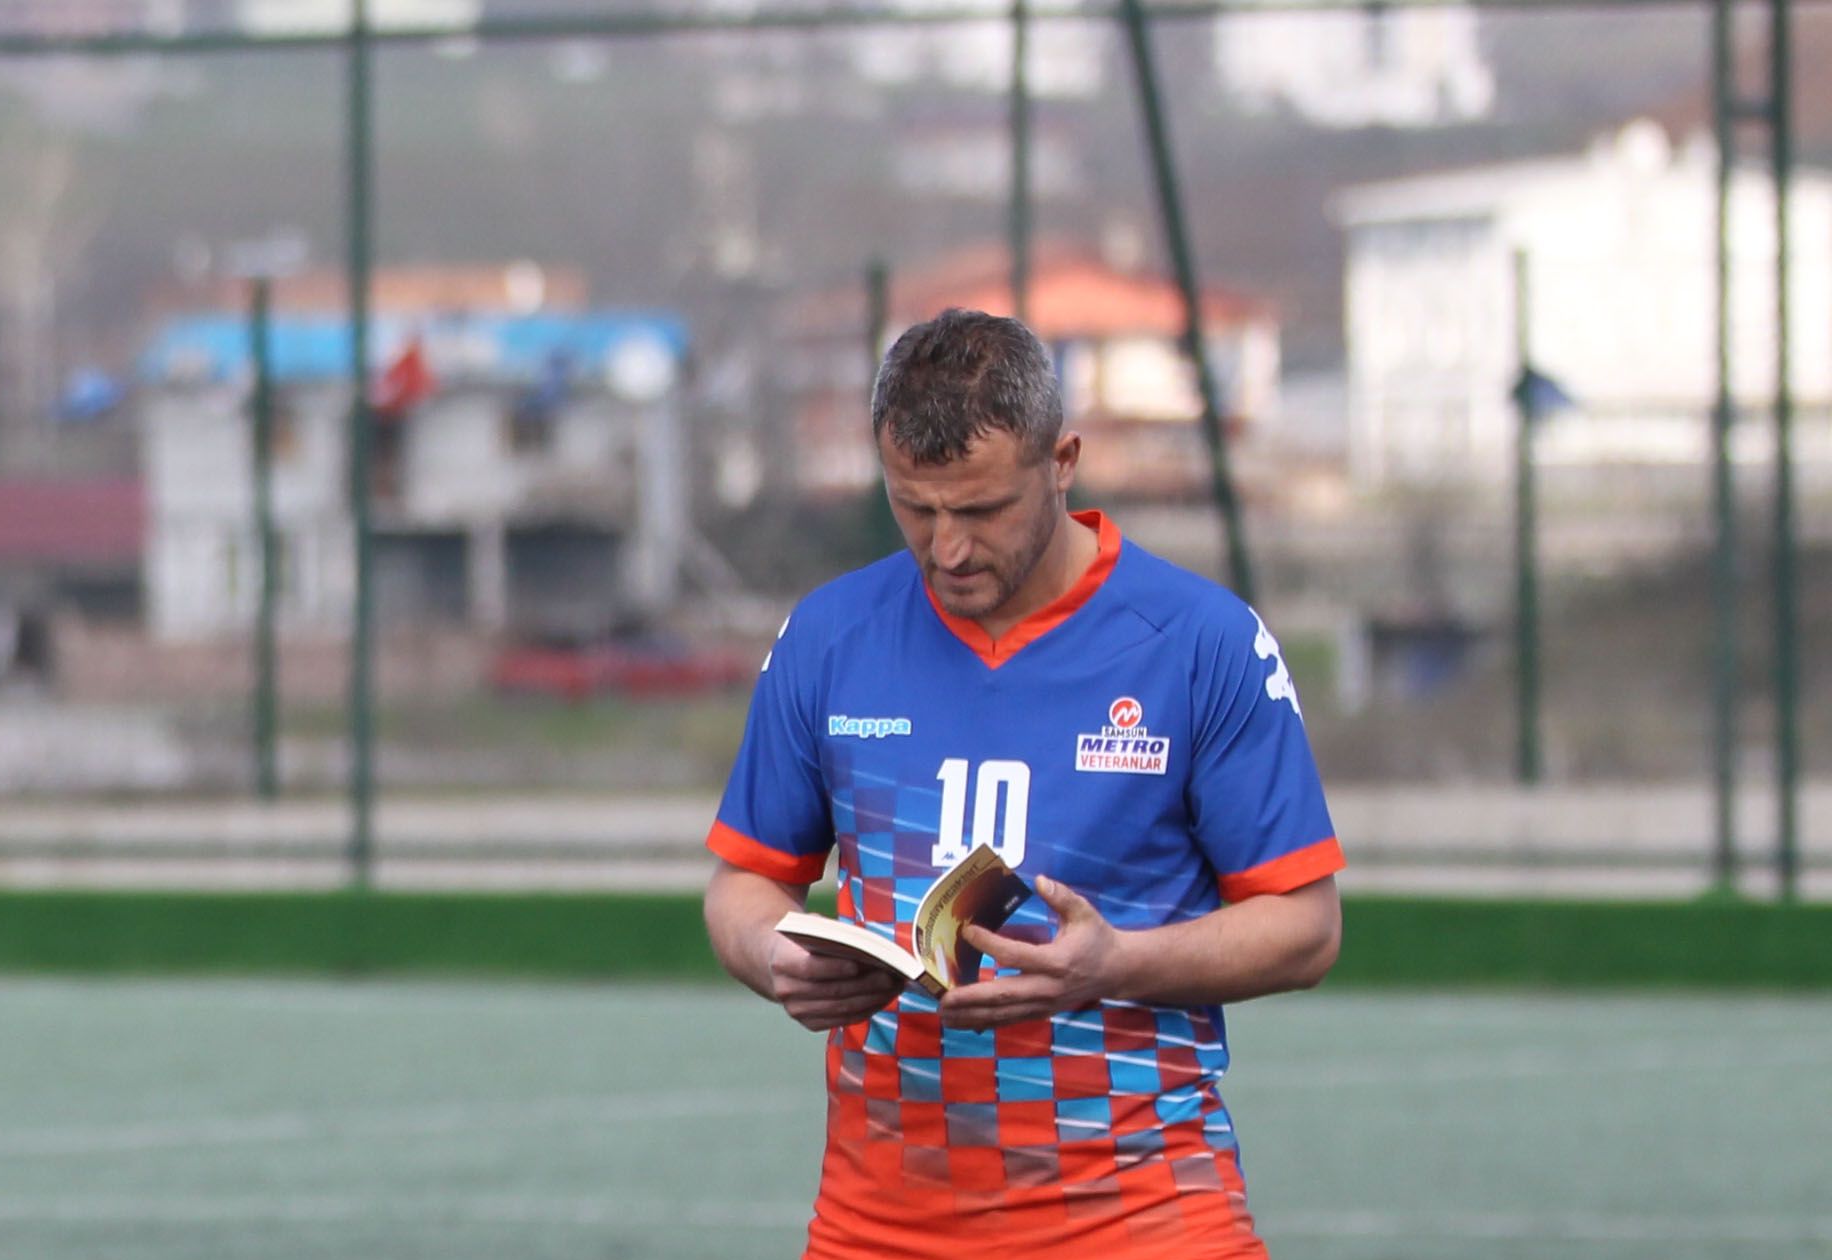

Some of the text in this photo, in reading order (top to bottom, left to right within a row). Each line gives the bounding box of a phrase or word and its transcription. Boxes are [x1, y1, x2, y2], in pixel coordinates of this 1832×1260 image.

[828, 715, 912, 739] Kappa
[1103, 727, 1145, 738] SAMSUN
[1080, 738, 1166, 755] METRO
[1080, 754, 1163, 772] VETERANLAR
[931, 758, 1031, 870] 10
